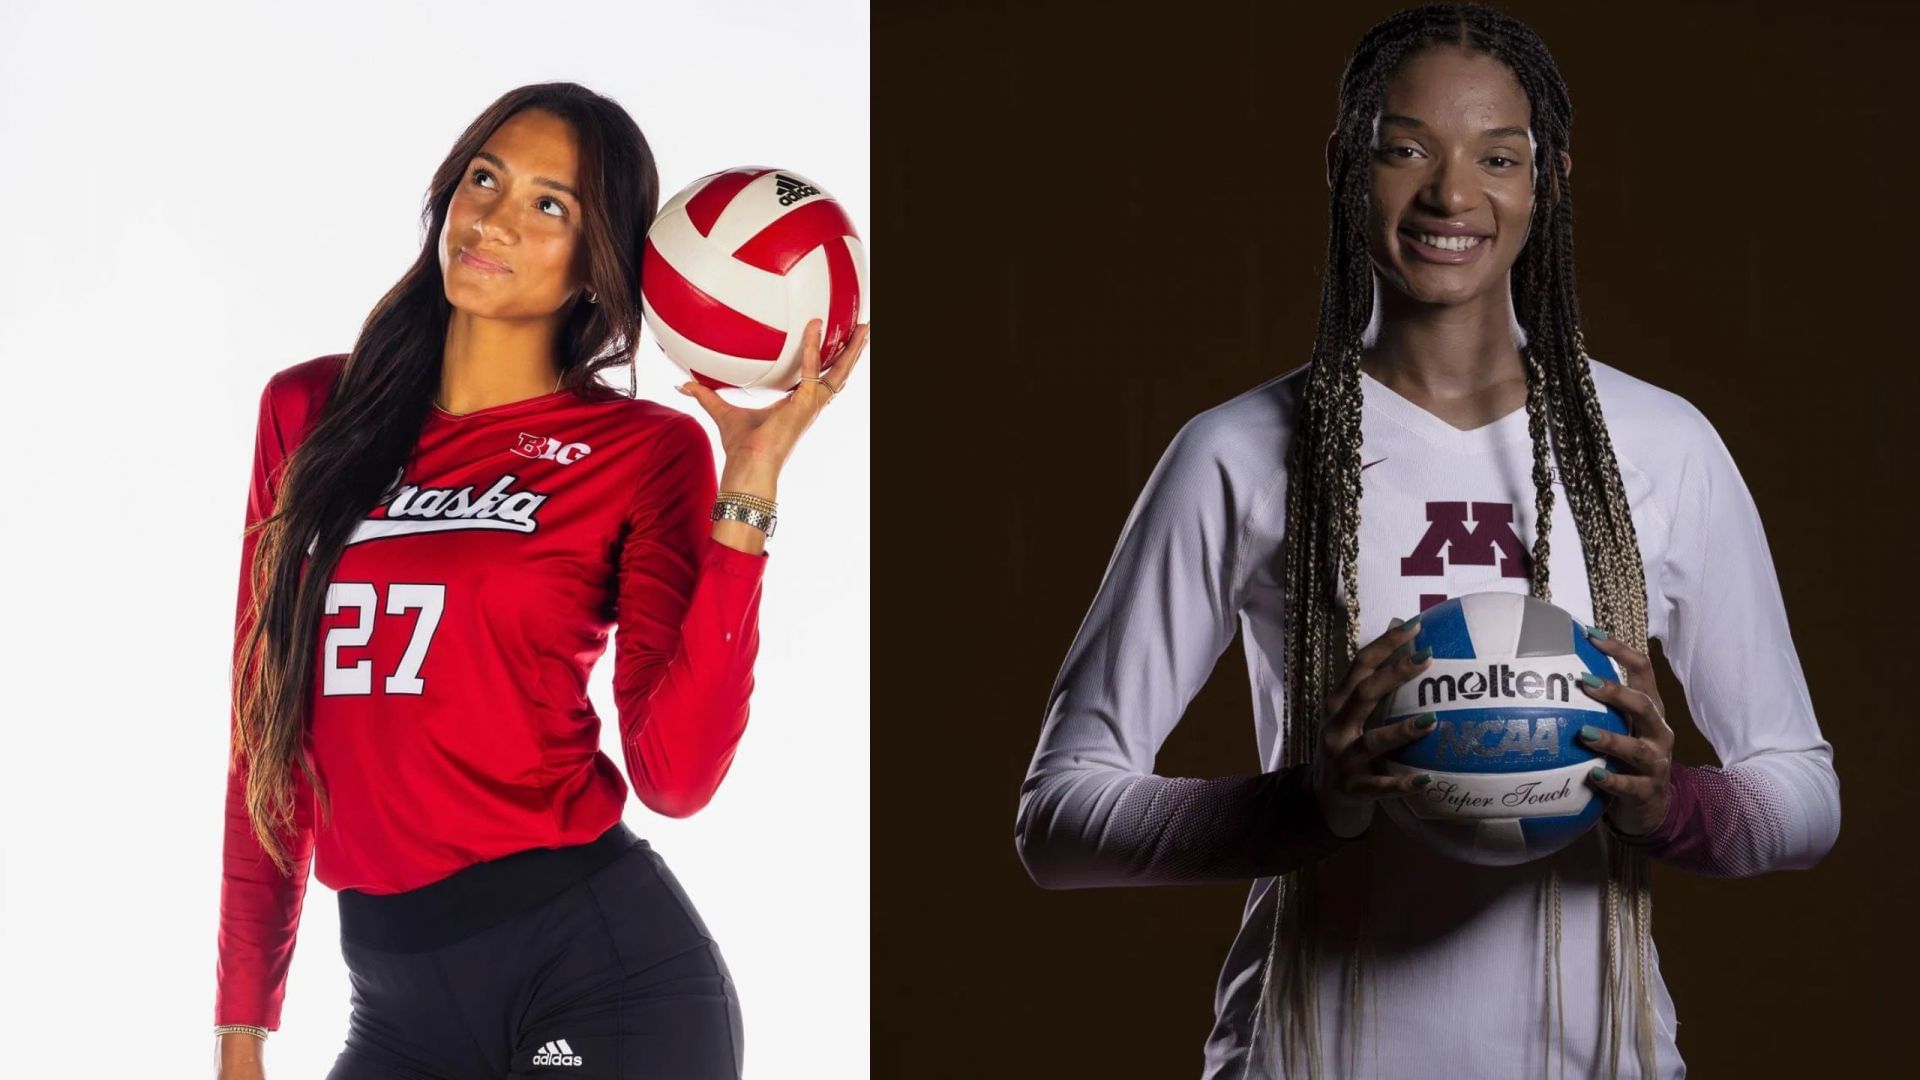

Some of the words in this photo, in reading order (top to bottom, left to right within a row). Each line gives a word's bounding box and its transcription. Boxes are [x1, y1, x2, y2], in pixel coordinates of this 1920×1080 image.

[778, 185, 821, 206] adidas
[382, 474, 548, 533] raska
[1400, 501, 1536, 578] M
[323, 582, 446, 695] 27
[1418, 664, 1569, 707] molten
[1437, 717, 1560, 758] NCAA
[1426, 781, 1494, 812] Super
[1501, 778, 1571, 807] Touch
[532, 1053, 583, 1067] adidas
